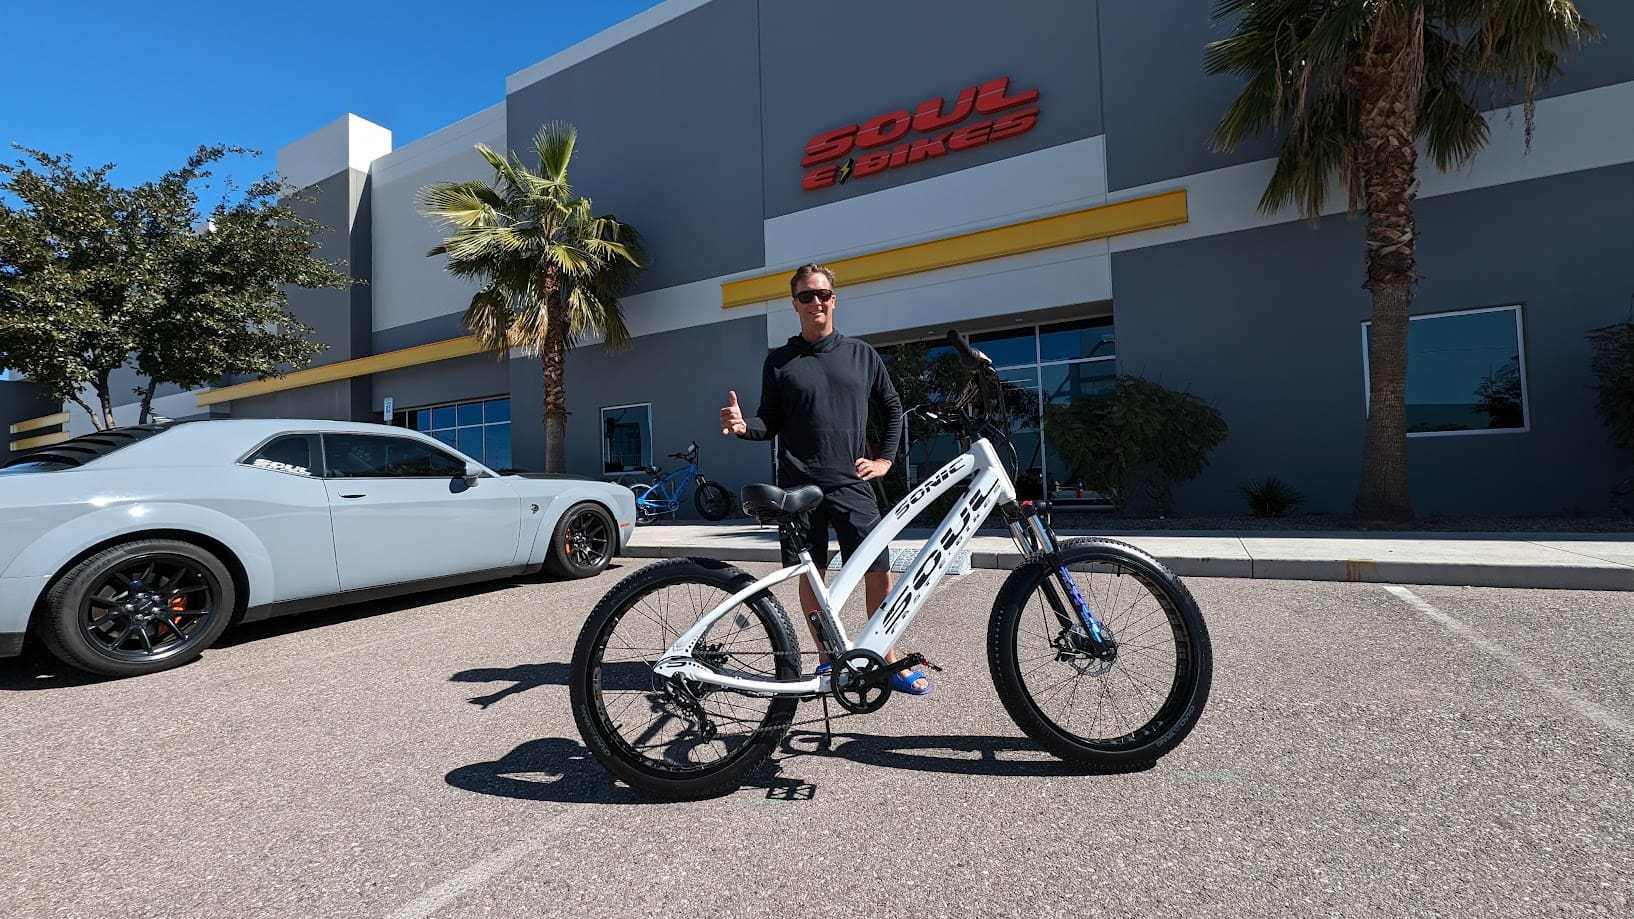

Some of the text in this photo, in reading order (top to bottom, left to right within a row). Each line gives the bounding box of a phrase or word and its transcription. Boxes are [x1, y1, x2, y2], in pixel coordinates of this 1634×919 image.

[800, 76, 1040, 168] SOUL
[895, 458, 965, 520] SONIC
[882, 478, 999, 635] SOUL
